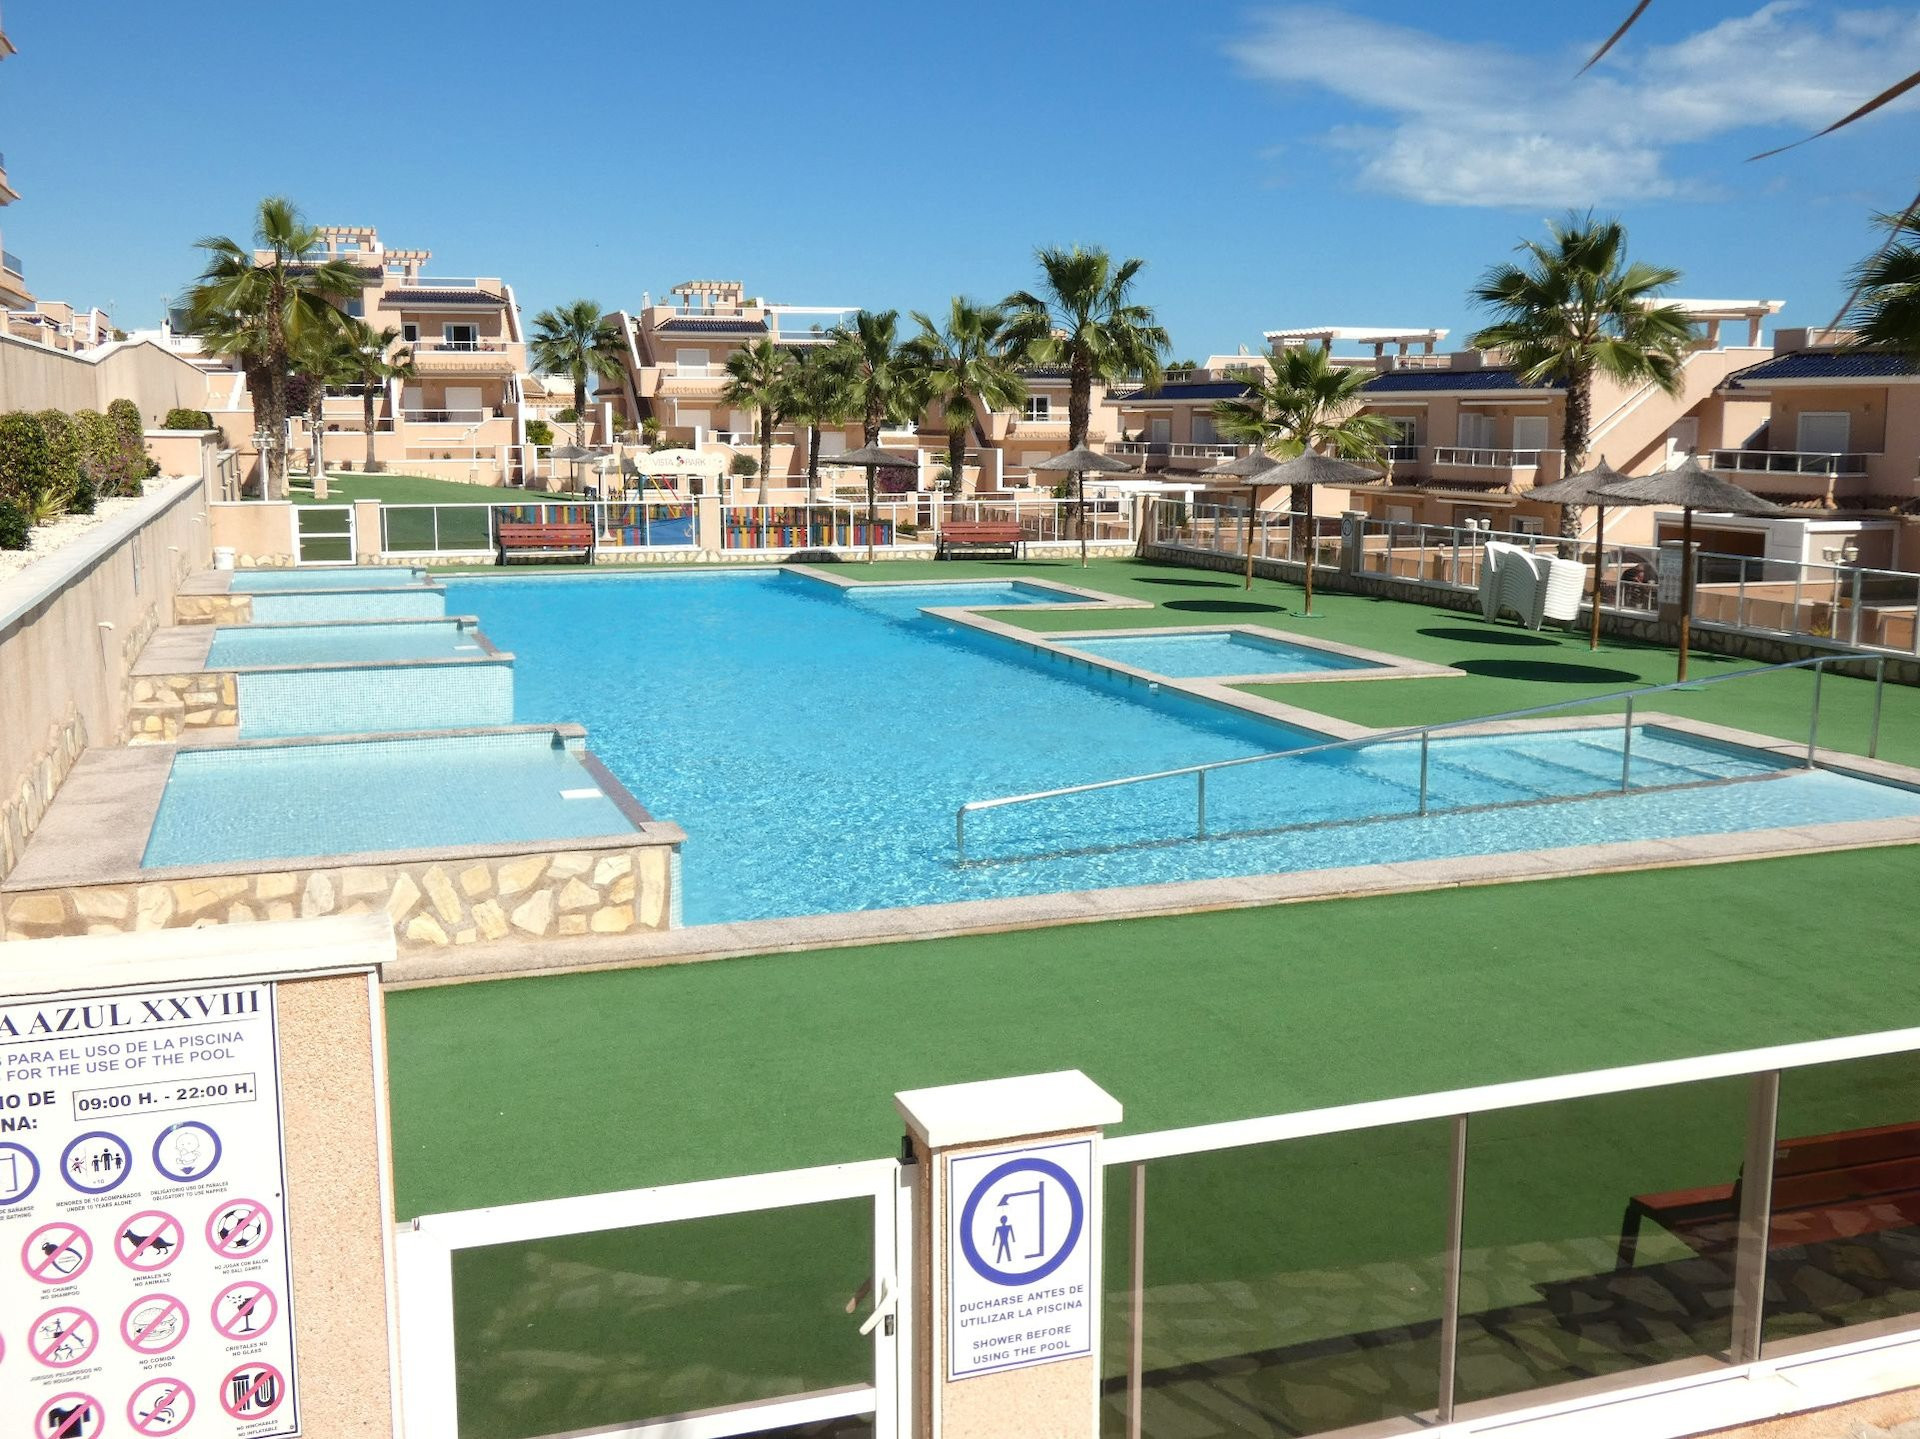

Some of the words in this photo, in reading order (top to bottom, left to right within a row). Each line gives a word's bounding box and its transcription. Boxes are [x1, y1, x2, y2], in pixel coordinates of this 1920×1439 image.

[652, 458, 674, 466] VISTA
[685, 458, 706, 466] PARK
[28, 1003, 131, 1035] AZUL
[141, 990, 261, 1024] XXVIII
[8, 1051, 54, 1066] PARA
[60, 1048, 81, 1060] EL
[85, 1044, 120, 1058] USO
[126, 1041, 148, 1053] DE
[153, 1038, 175, 1050] LA
[179, 1031, 244, 1048] PISCINA
[7, 1068, 42, 1082] FOR
[47, 1063, 80, 1077] THE
[86, 1059, 119, 1073] USE
[125, 1057, 147, 1069] OF
[152, 1053, 184, 1066] THE
[190, 1048, 235, 1062] POOL
[28, 1090, 56, 1107] DE
[78, 1094, 132, 1111] 09:00
[138, 1091, 158, 1105] H.
[176, 1084, 228, 1100] 22:00
[234, 1082, 254, 1095] H.
[1, 1116, 37, 1133] NA:
[960, 1295, 1024, 1313] DUCHARSE
[1027, 1287, 1065, 1302] ANTES
[1069, 1284, 1084, 1295] DE
[960, 1311, 1015, 1328] UTILIZAR
[1018, 1308, 1033, 1318] LA
[1036, 1299, 1083, 1315] PISCINA
[973, 1333, 1022, 1350] SHOWER
[1026, 1324, 1072, 1340] BEFORE
[973, 1350, 1010, 1364] USING
[1014, 1345, 1037, 1357] THE
[1040, 1340, 1071, 1352] POOL
